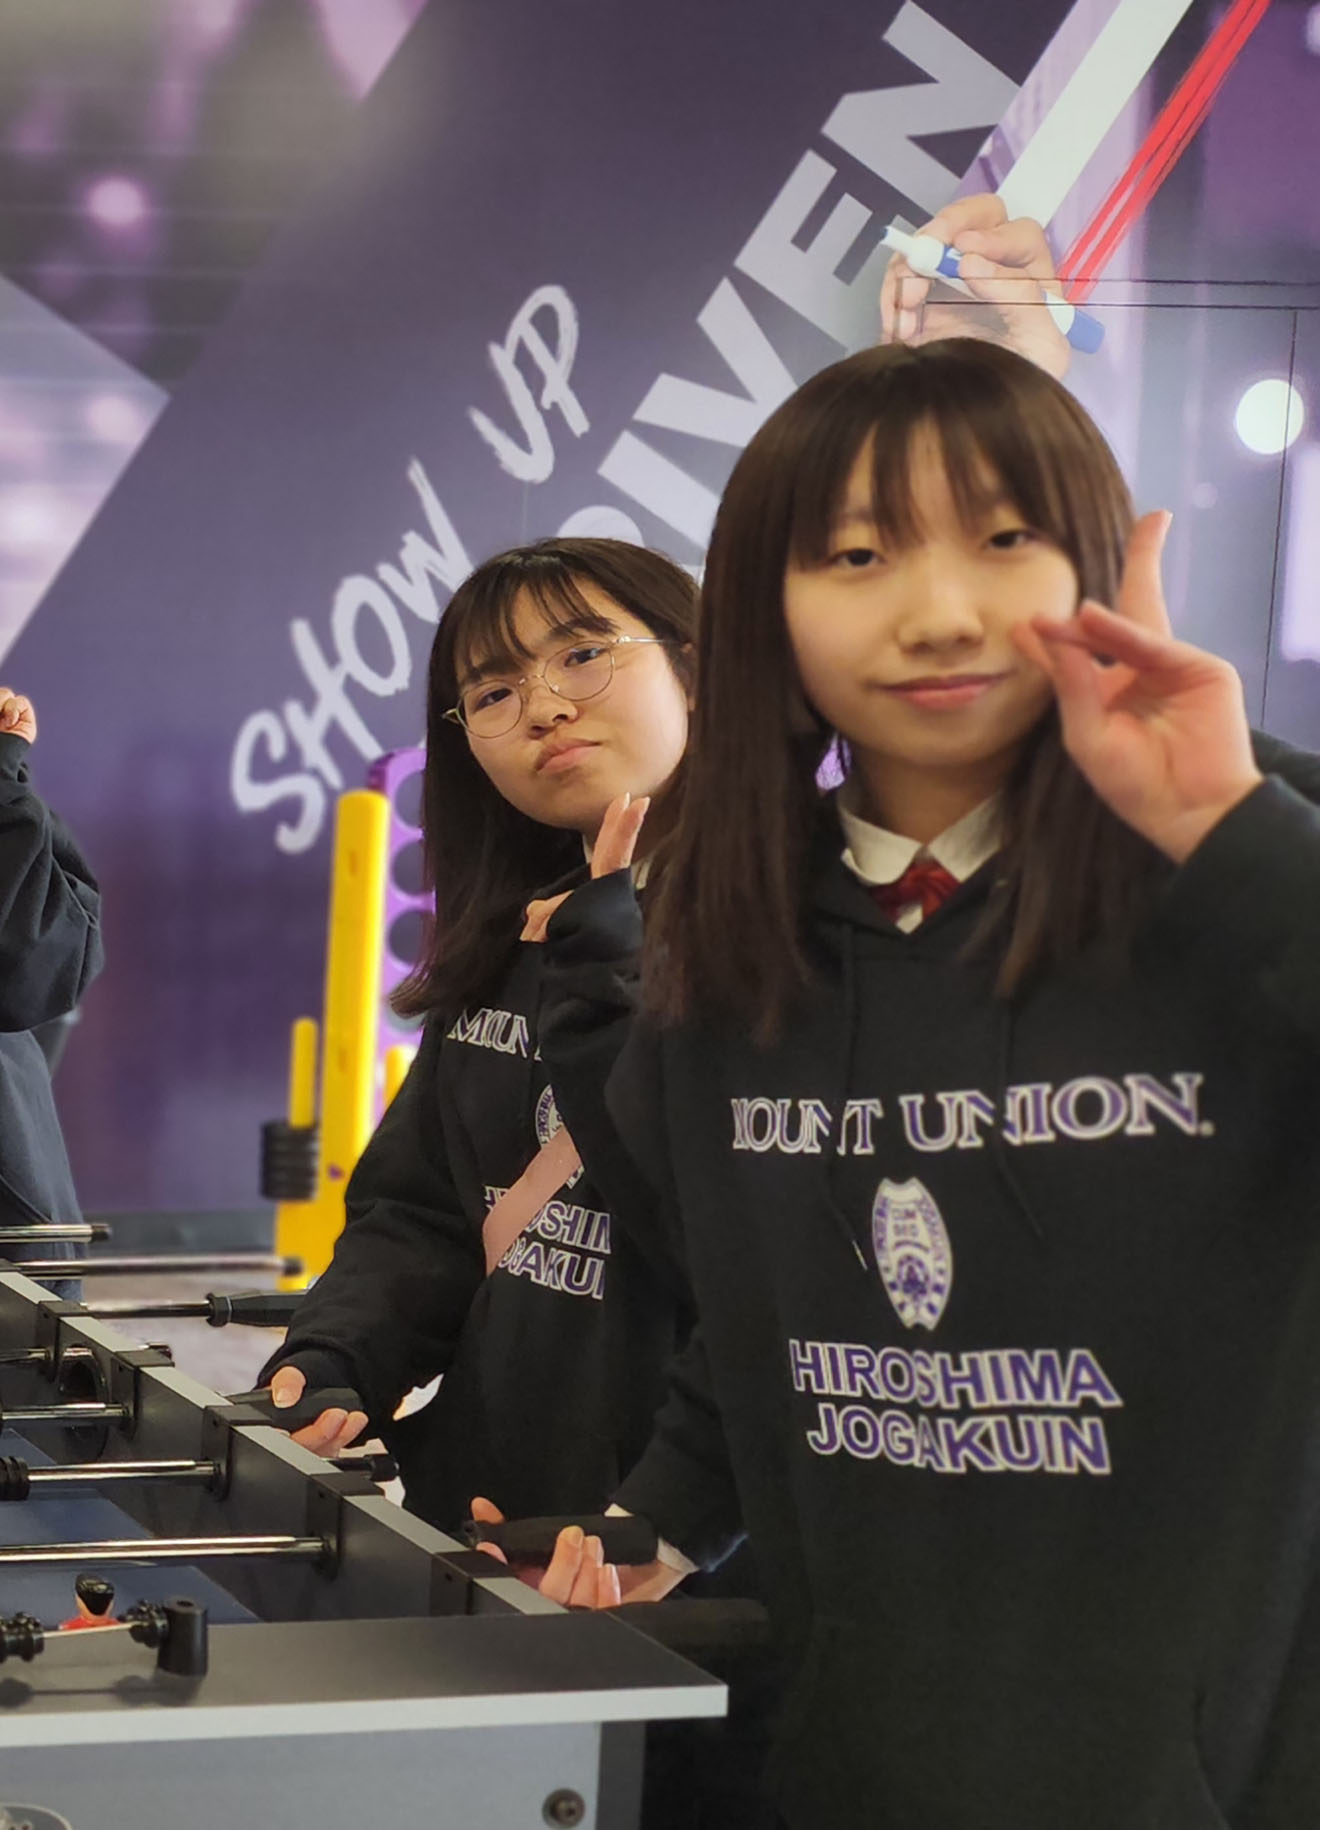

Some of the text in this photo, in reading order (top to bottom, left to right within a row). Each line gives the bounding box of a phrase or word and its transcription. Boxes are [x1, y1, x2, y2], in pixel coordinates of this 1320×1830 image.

[231, 283, 591, 855] SHOW UP
[446, 1007, 543, 1062] MUN
[789, 1338, 1123, 1408] HIROSHIMA
[805, 1403, 1112, 1475] JOGAKUIN
